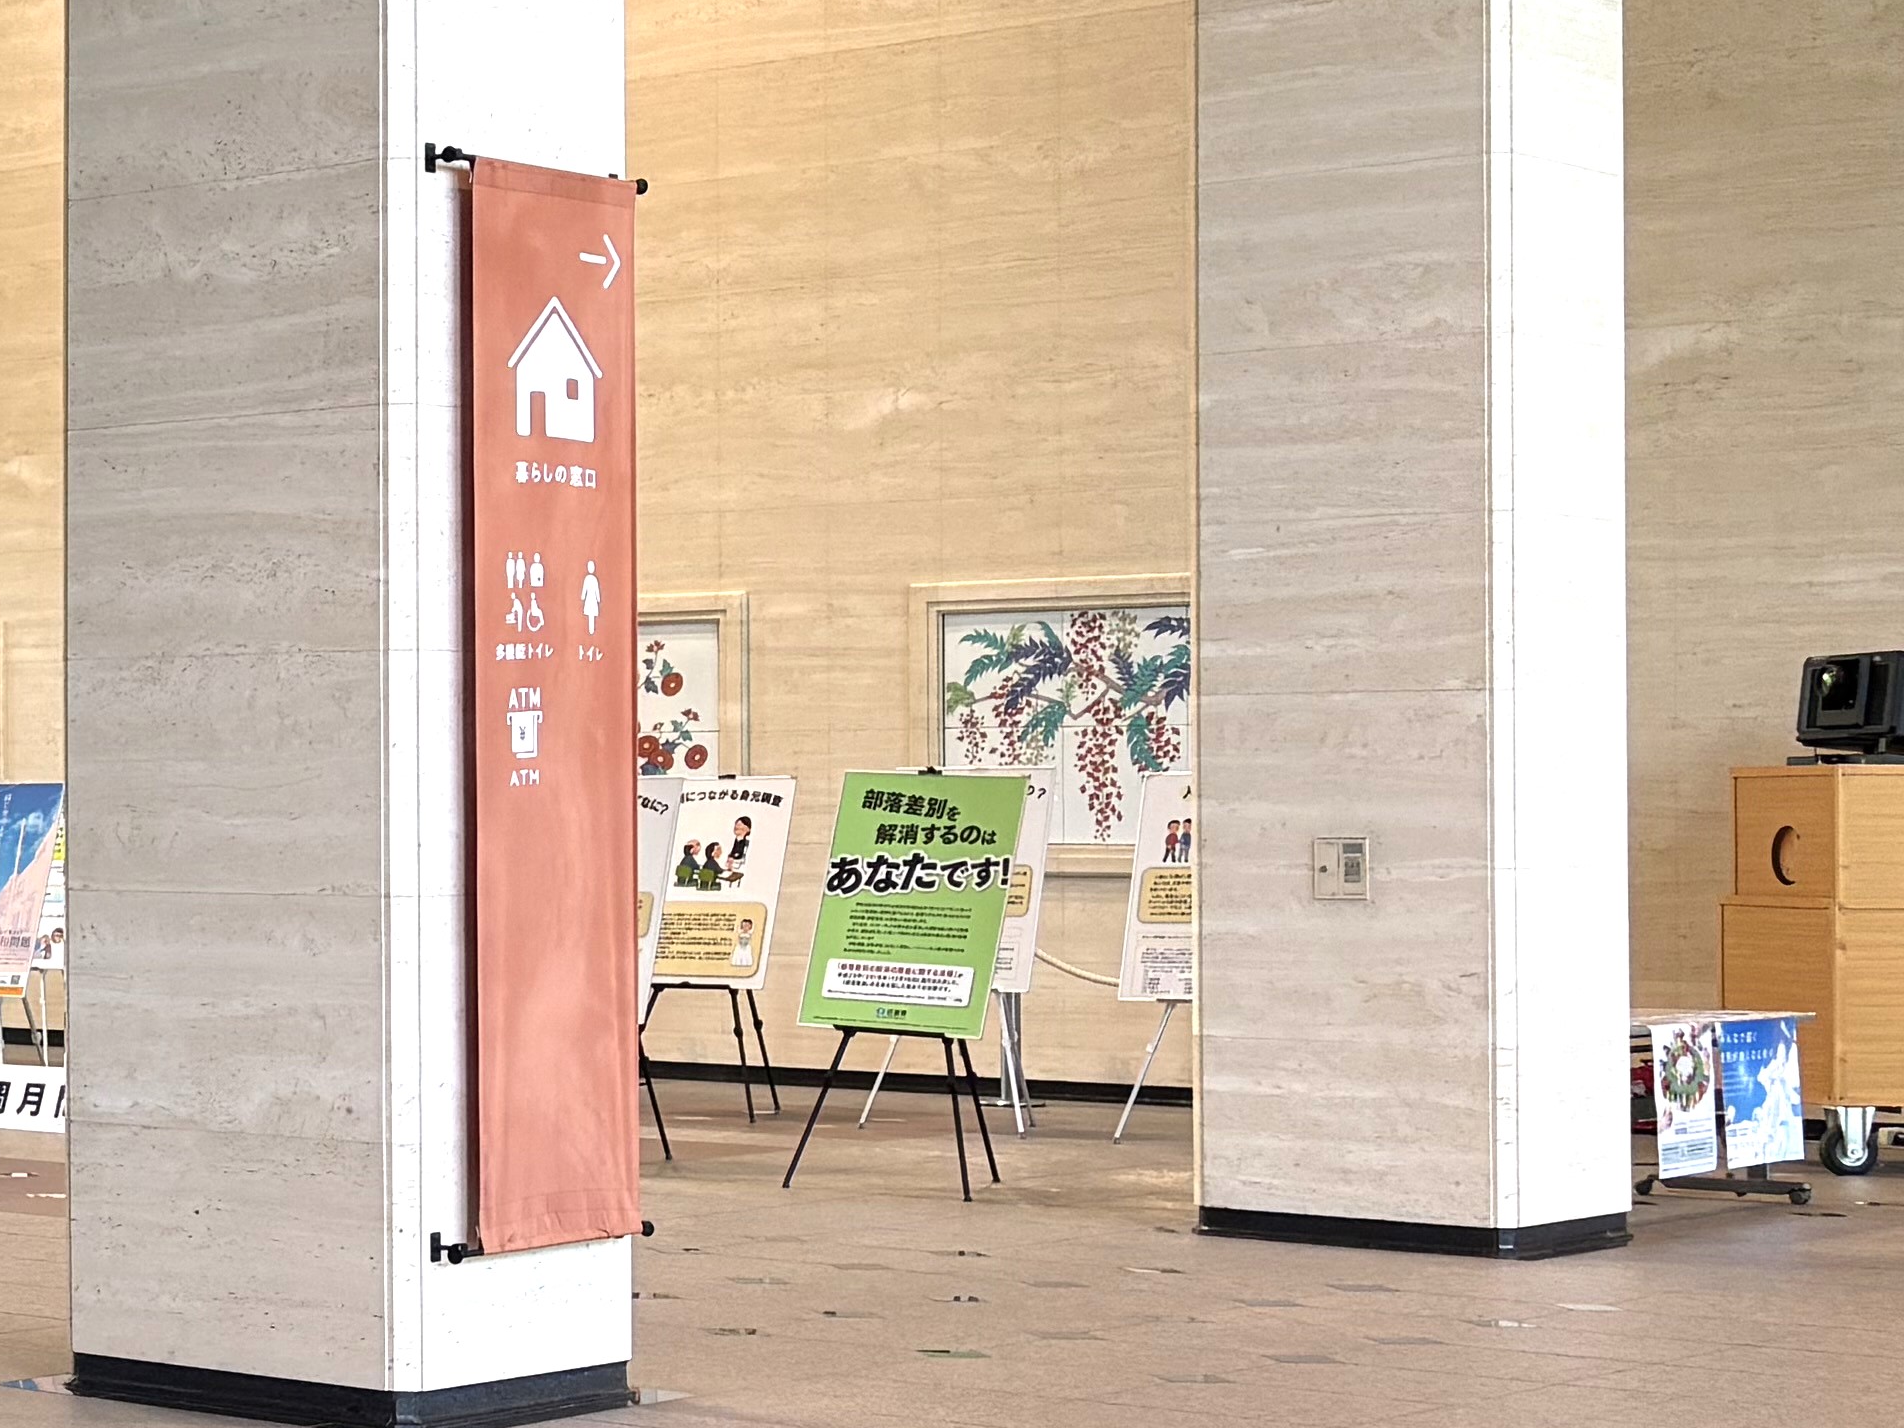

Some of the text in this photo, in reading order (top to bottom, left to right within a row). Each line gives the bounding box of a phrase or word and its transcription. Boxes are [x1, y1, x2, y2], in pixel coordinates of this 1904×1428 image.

[515, 461, 597, 489] 暮らしの窓口
[578, 644, 604, 662] トイレ
[508, 687, 541, 710] ATM
[510, 769, 540, 787] ATM
[861, 788, 961, 821] 部落差別を
[874, 823, 997, 846] 解消するのは
[827, 852, 1011, 895] あなたです!
